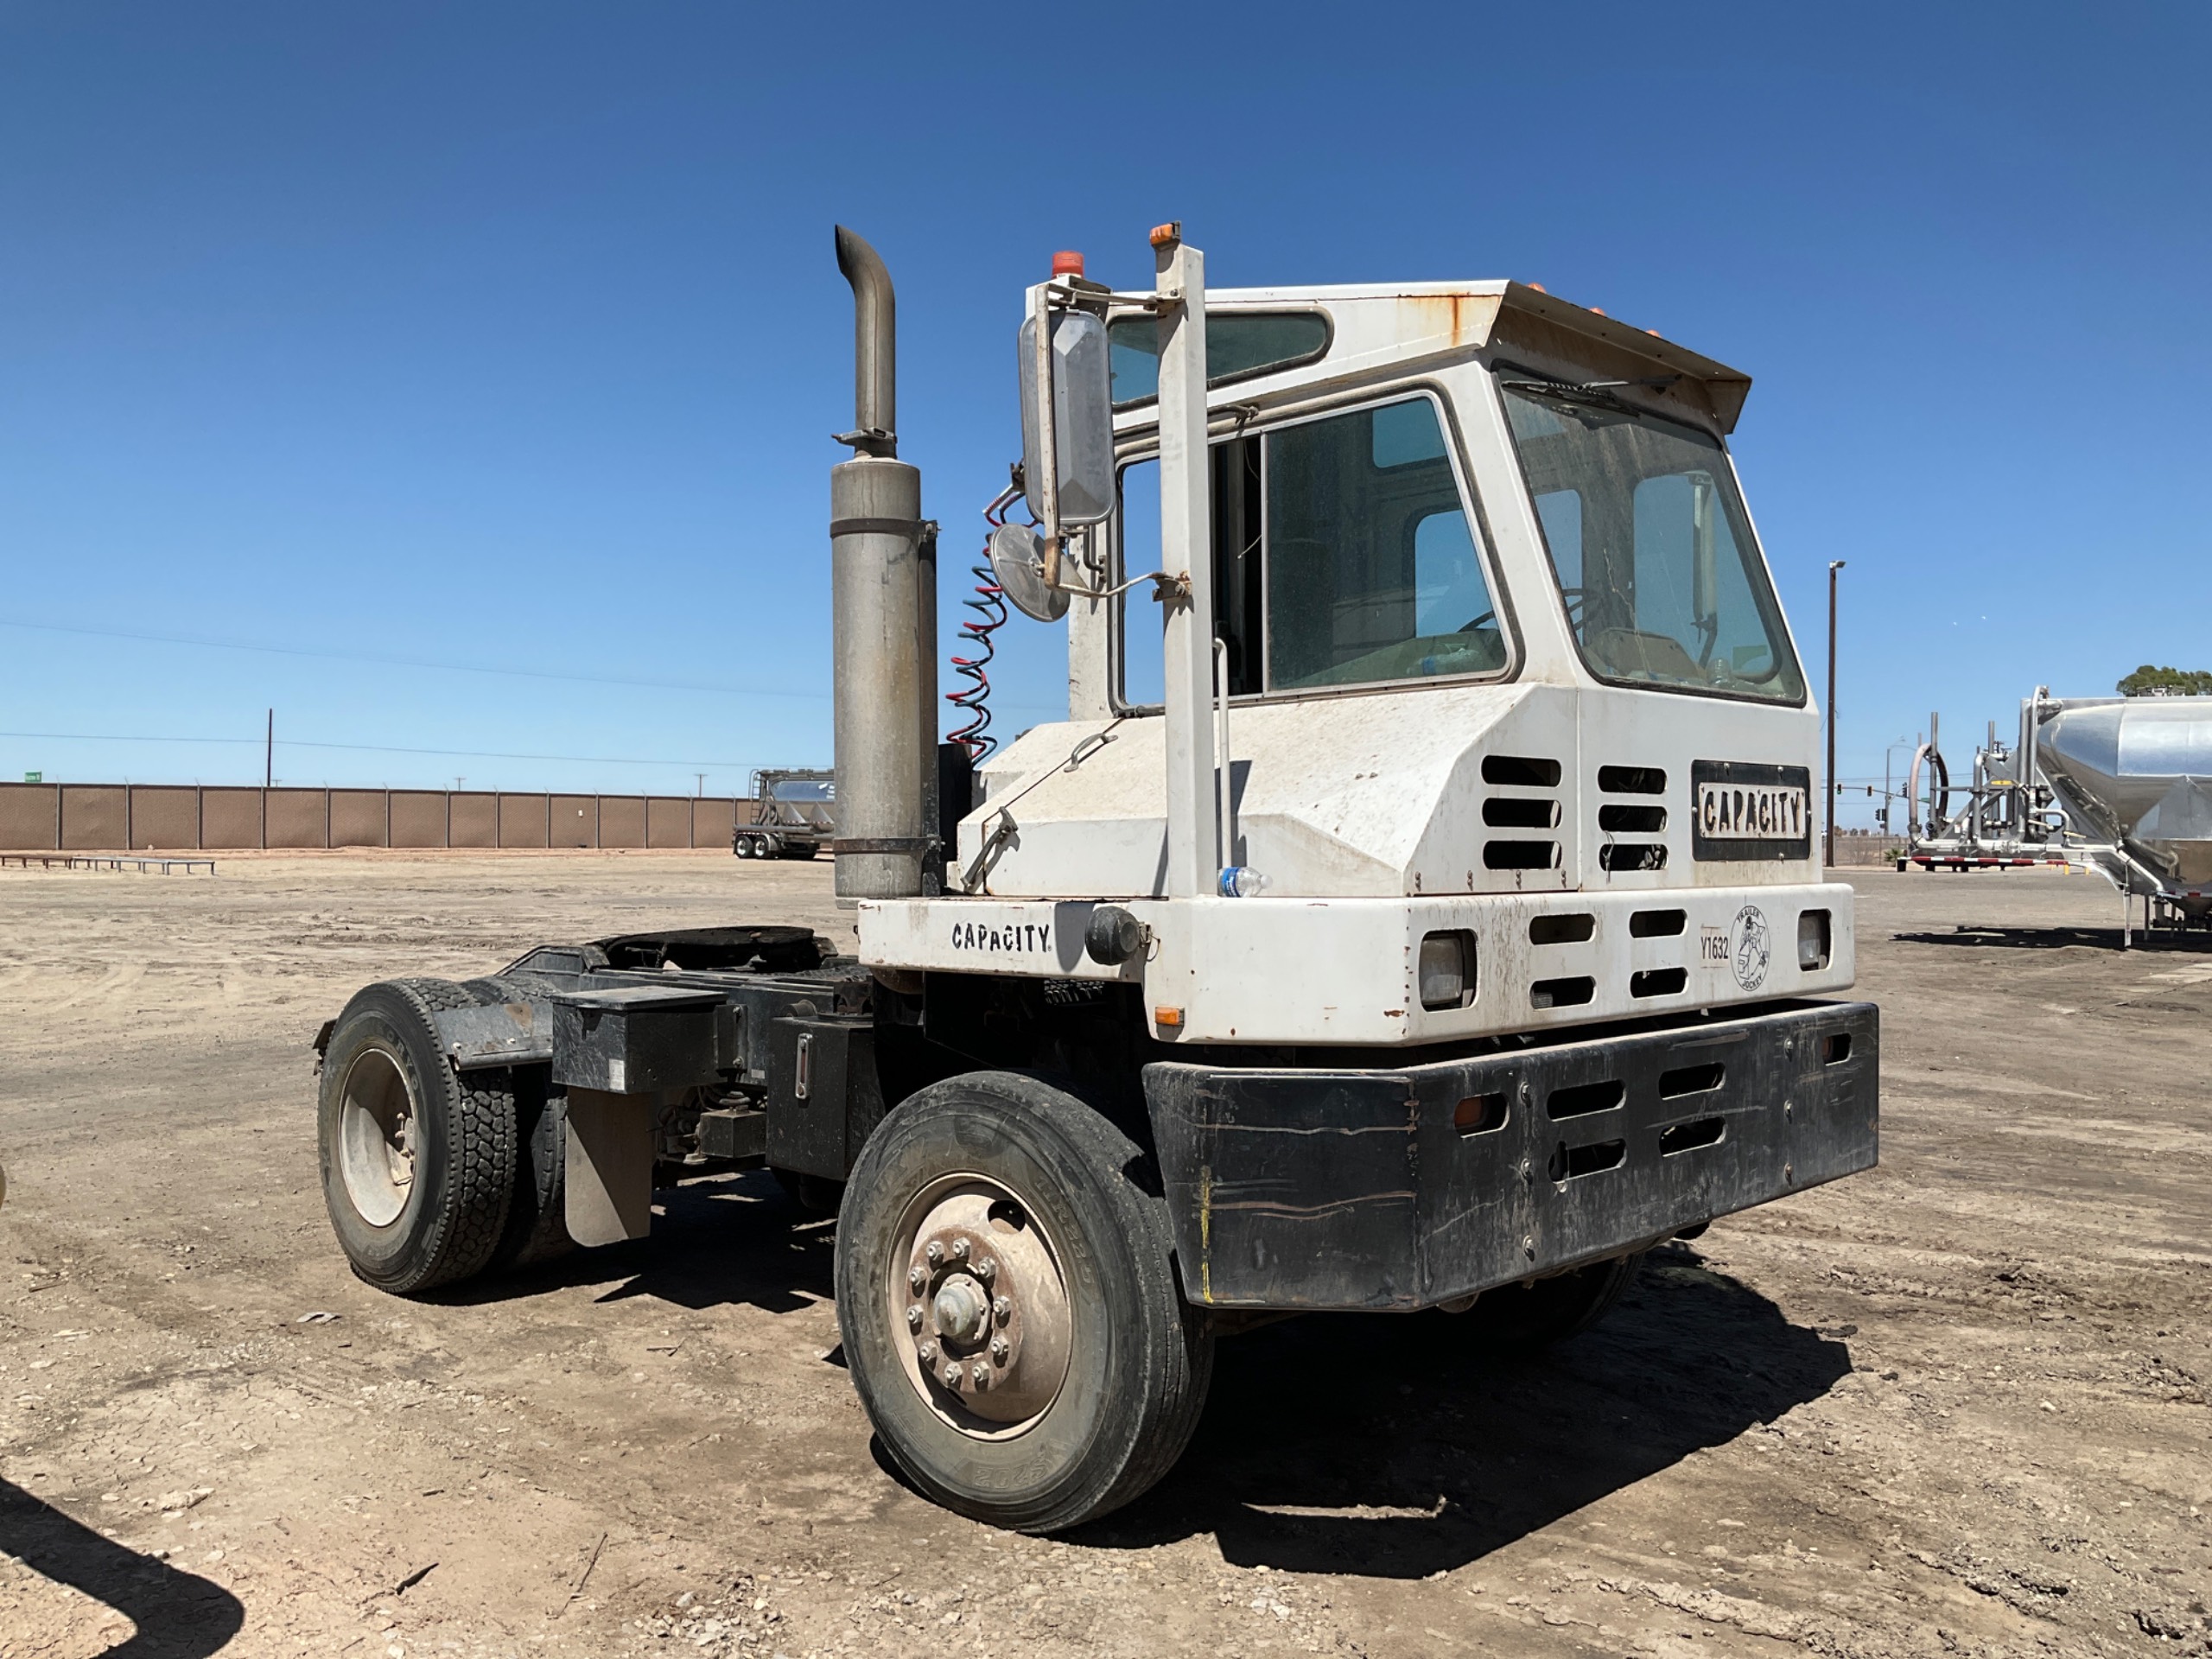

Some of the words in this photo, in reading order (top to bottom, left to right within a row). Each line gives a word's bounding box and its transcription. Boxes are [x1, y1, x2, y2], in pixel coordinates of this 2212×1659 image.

[1704, 790, 1801, 833] CAPACITY
[1736, 906, 1760, 923] TRAILER
[952, 923, 1050, 952] CAPACITY
[1700, 936, 1729, 960] Y1632
[1742, 973, 1762, 989] JOCKEY
